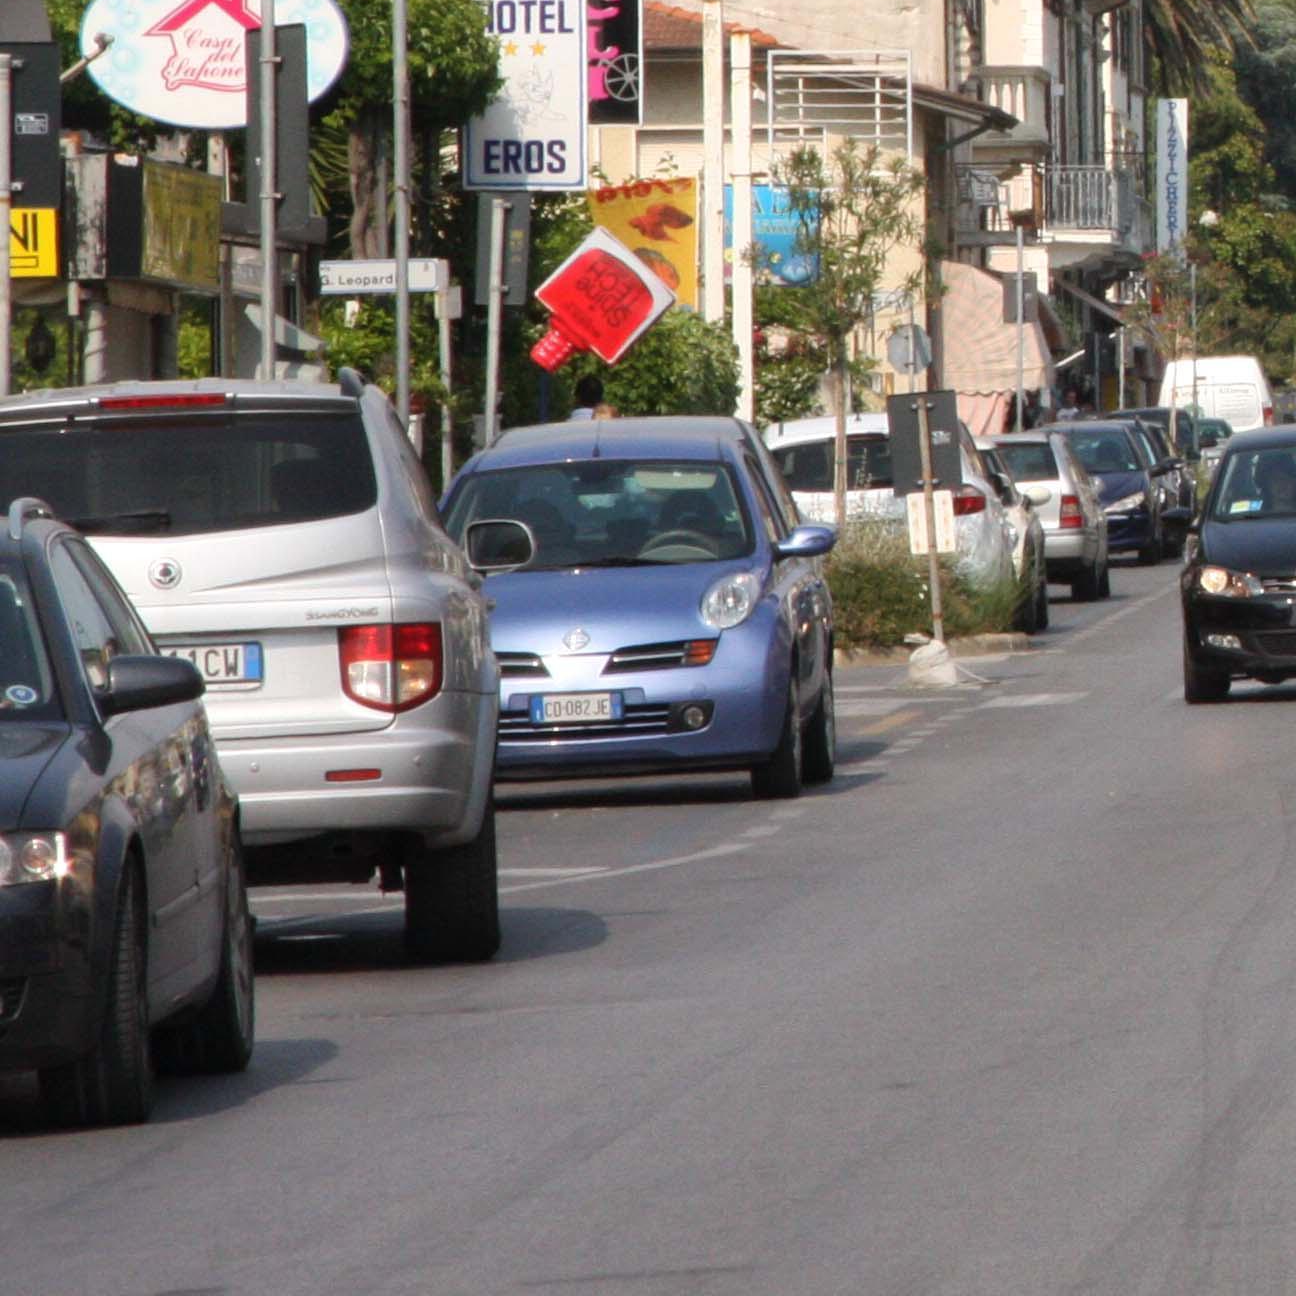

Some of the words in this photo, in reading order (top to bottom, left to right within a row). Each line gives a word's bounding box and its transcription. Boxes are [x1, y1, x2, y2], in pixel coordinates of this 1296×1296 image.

[184, 29, 234, 49] Casa
[483, 140, 566, 174] EROS
[338, 274, 398, 288] Leopard
